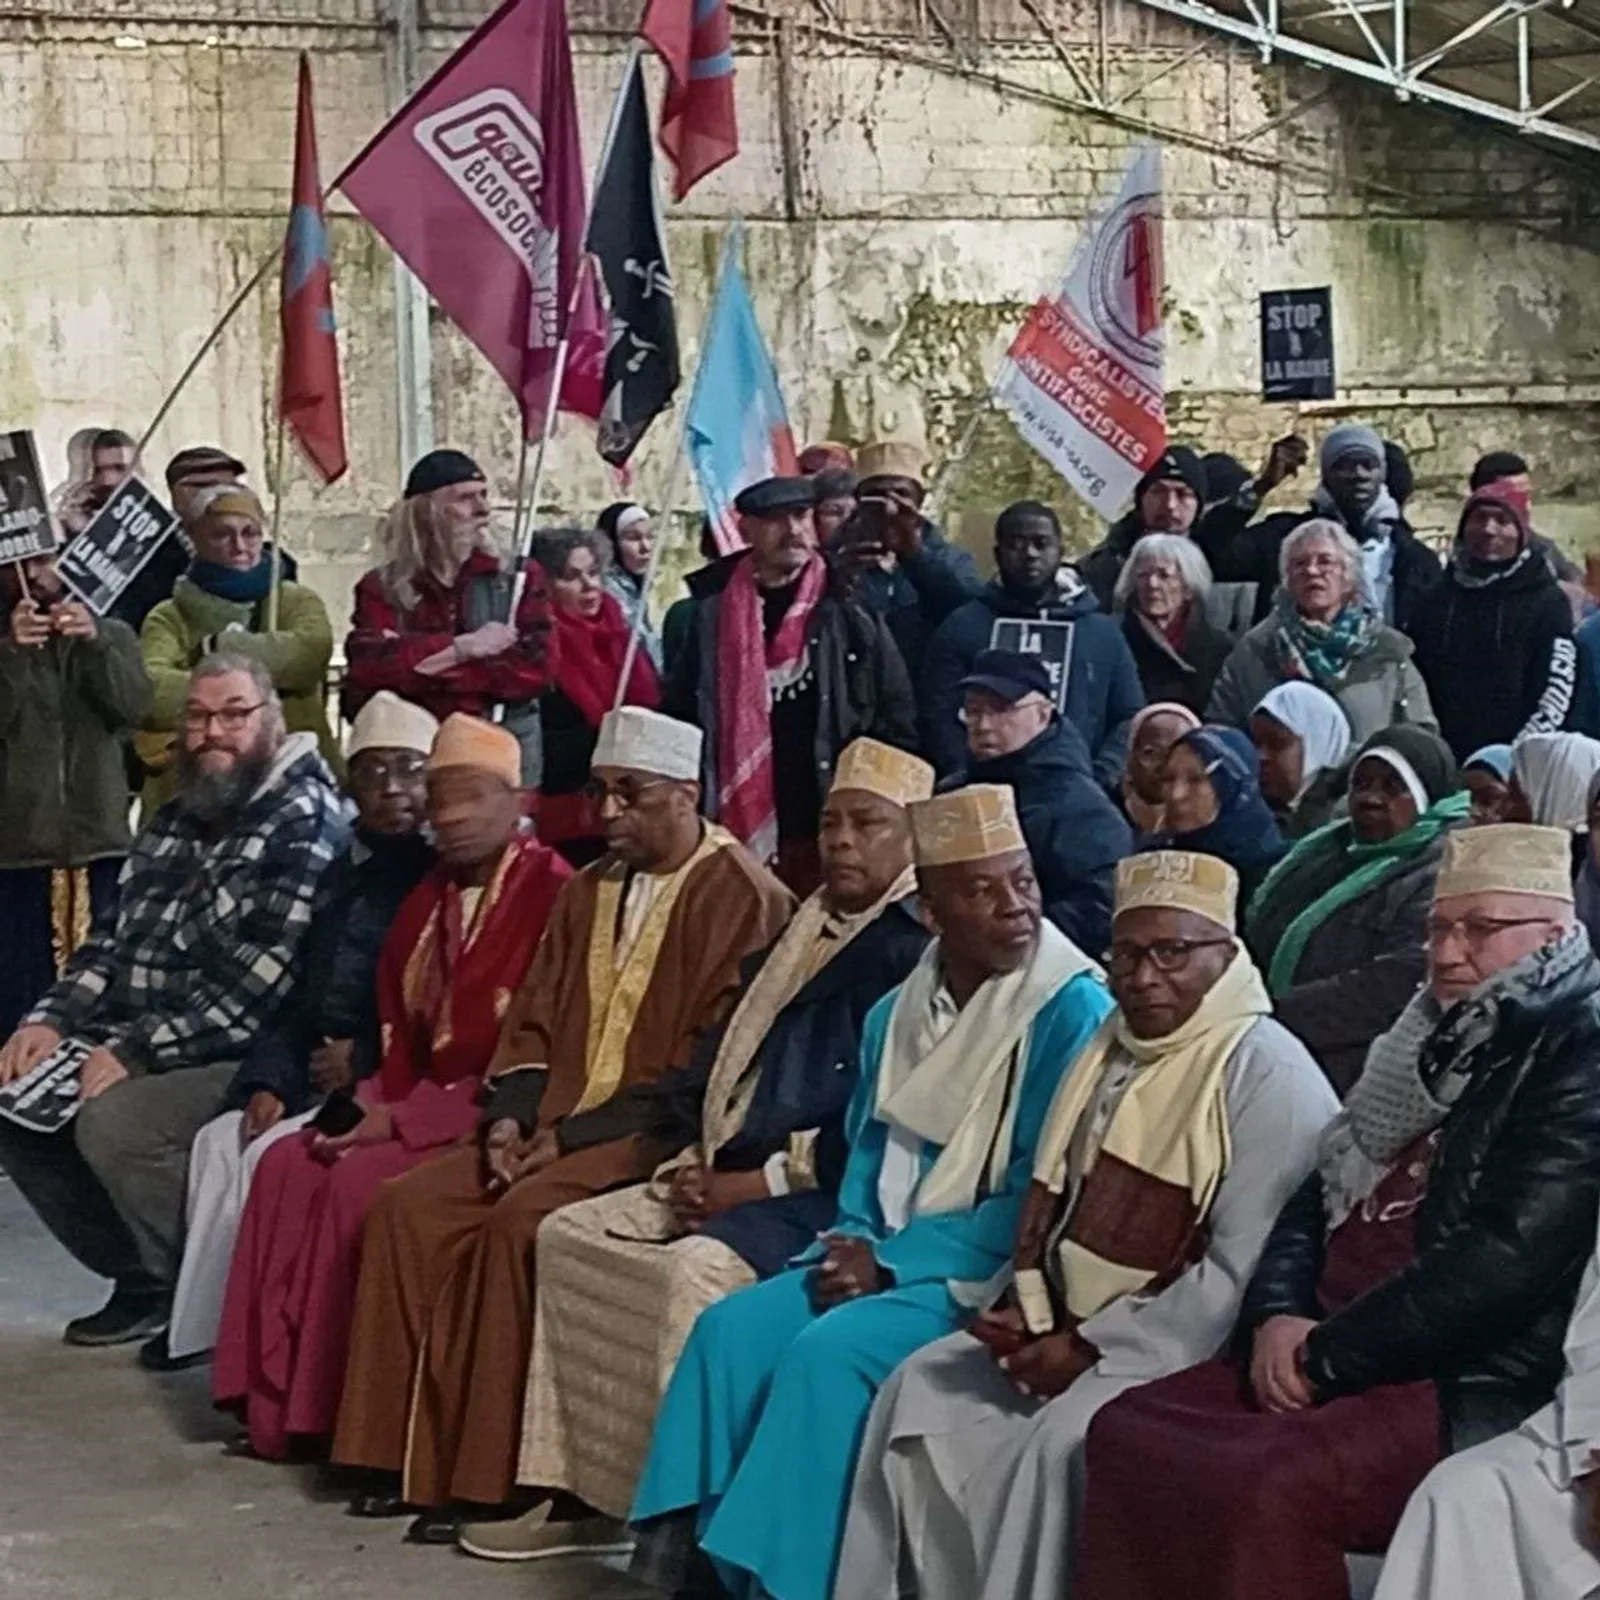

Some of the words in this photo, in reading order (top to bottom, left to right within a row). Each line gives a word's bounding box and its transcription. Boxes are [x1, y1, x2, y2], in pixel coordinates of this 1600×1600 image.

[1267, 303, 1322, 331] STOP
[1038, 309, 1166, 424] SYNDICALISTE
[110, 494, 163, 542] STOP
